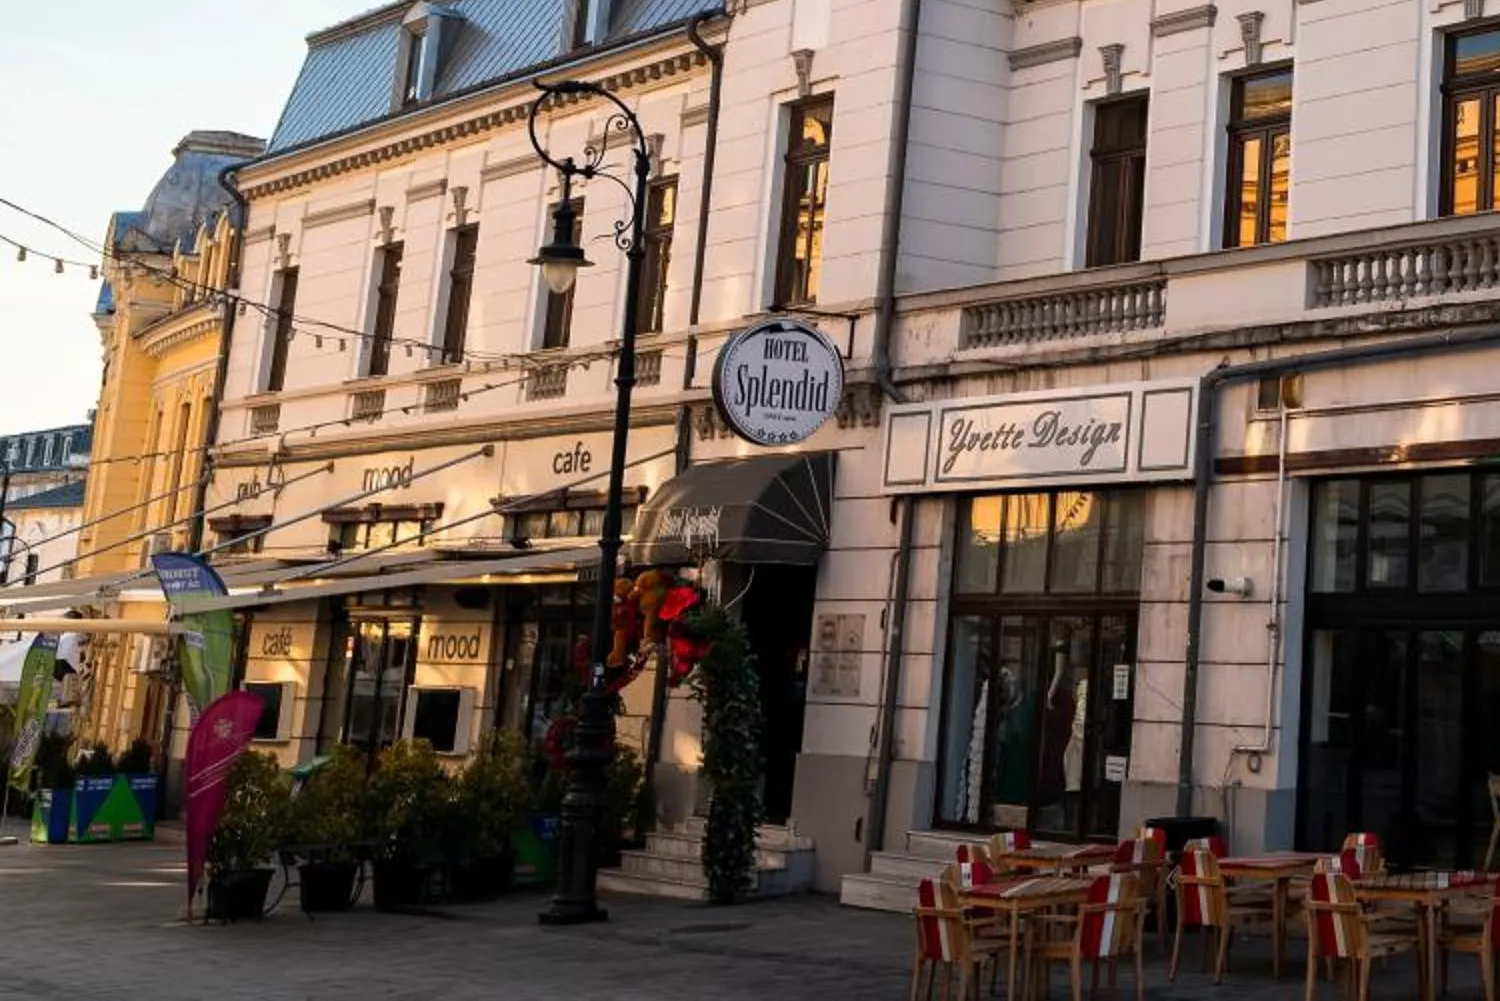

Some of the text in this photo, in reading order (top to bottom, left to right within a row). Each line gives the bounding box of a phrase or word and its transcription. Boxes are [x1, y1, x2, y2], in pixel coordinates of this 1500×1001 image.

[763, 337, 809, 363] HOTEL
[735, 363, 829, 417] Splendid
[943, 410, 1123, 473] Yvette Design
[363, 455, 415, 492] mood
[262, 626, 293, 656] café
[427, 625, 482, 660] mood
